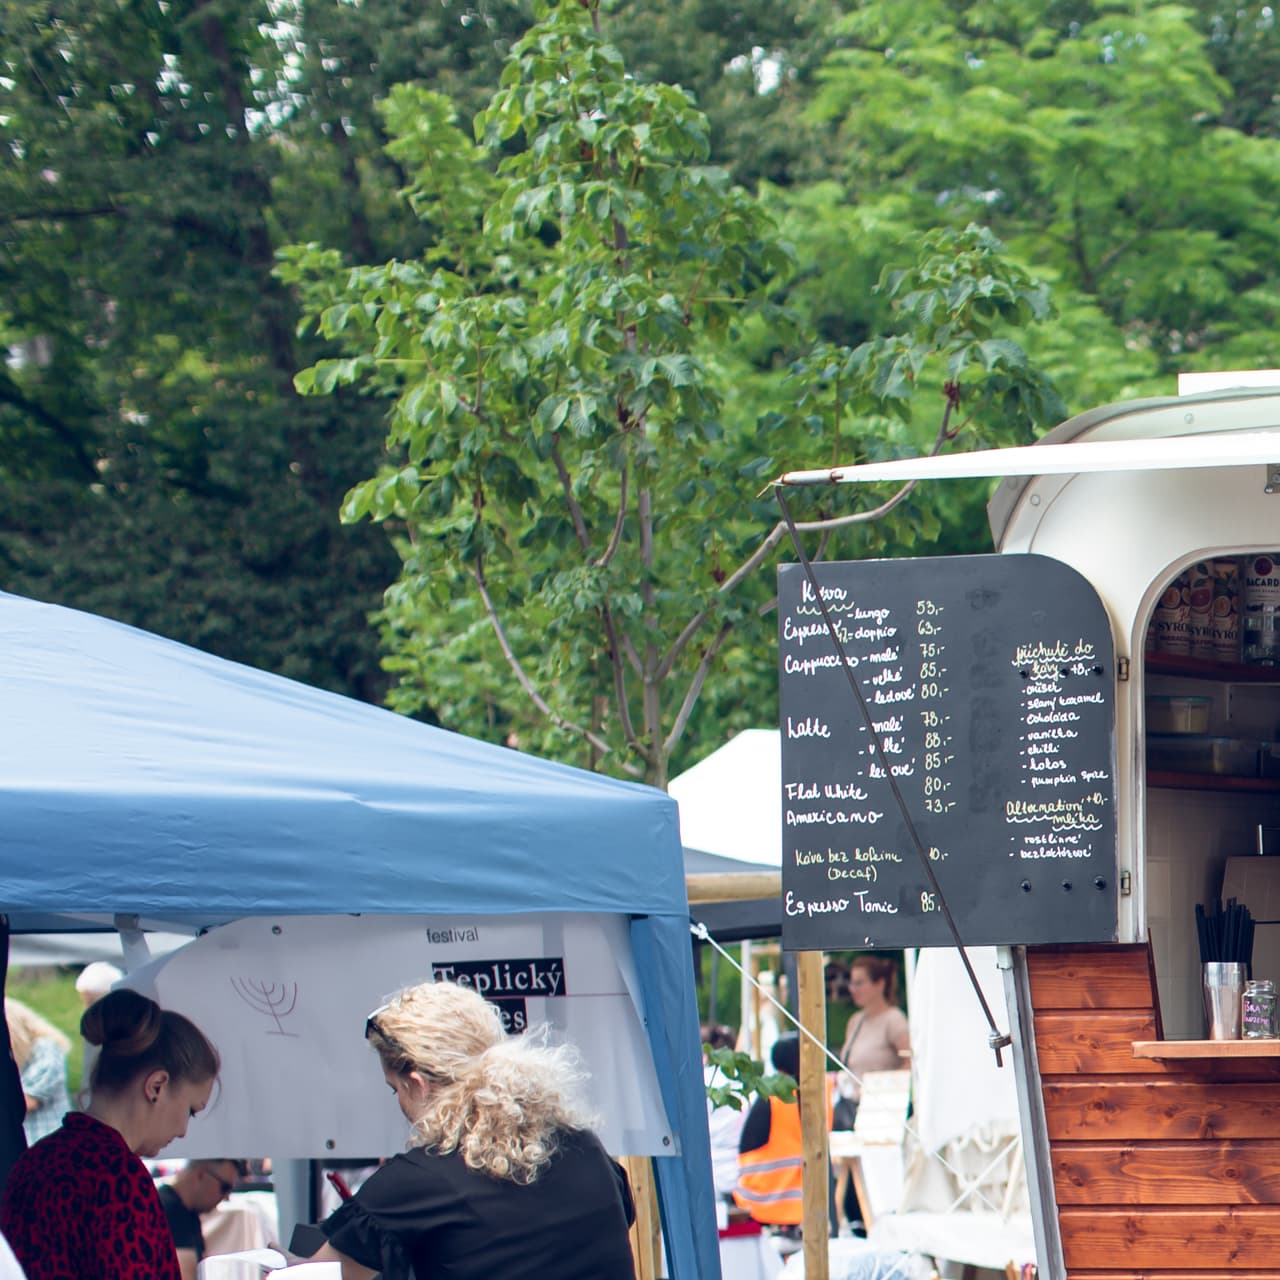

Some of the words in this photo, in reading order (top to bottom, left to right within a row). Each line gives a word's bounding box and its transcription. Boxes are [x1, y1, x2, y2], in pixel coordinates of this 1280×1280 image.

[1075, 638, 1093, 654] do
[869, 737, 905, 754] vlké
[785, 783, 820, 801] Flat
[786, 809, 883, 826] Americano
[828, 848, 849, 863] bez
[785, 890, 849, 917] Espresso
[853, 890, 898, 914] Tonic
[426, 927, 479, 944] festival
[432, 963, 562, 997] Teplický
